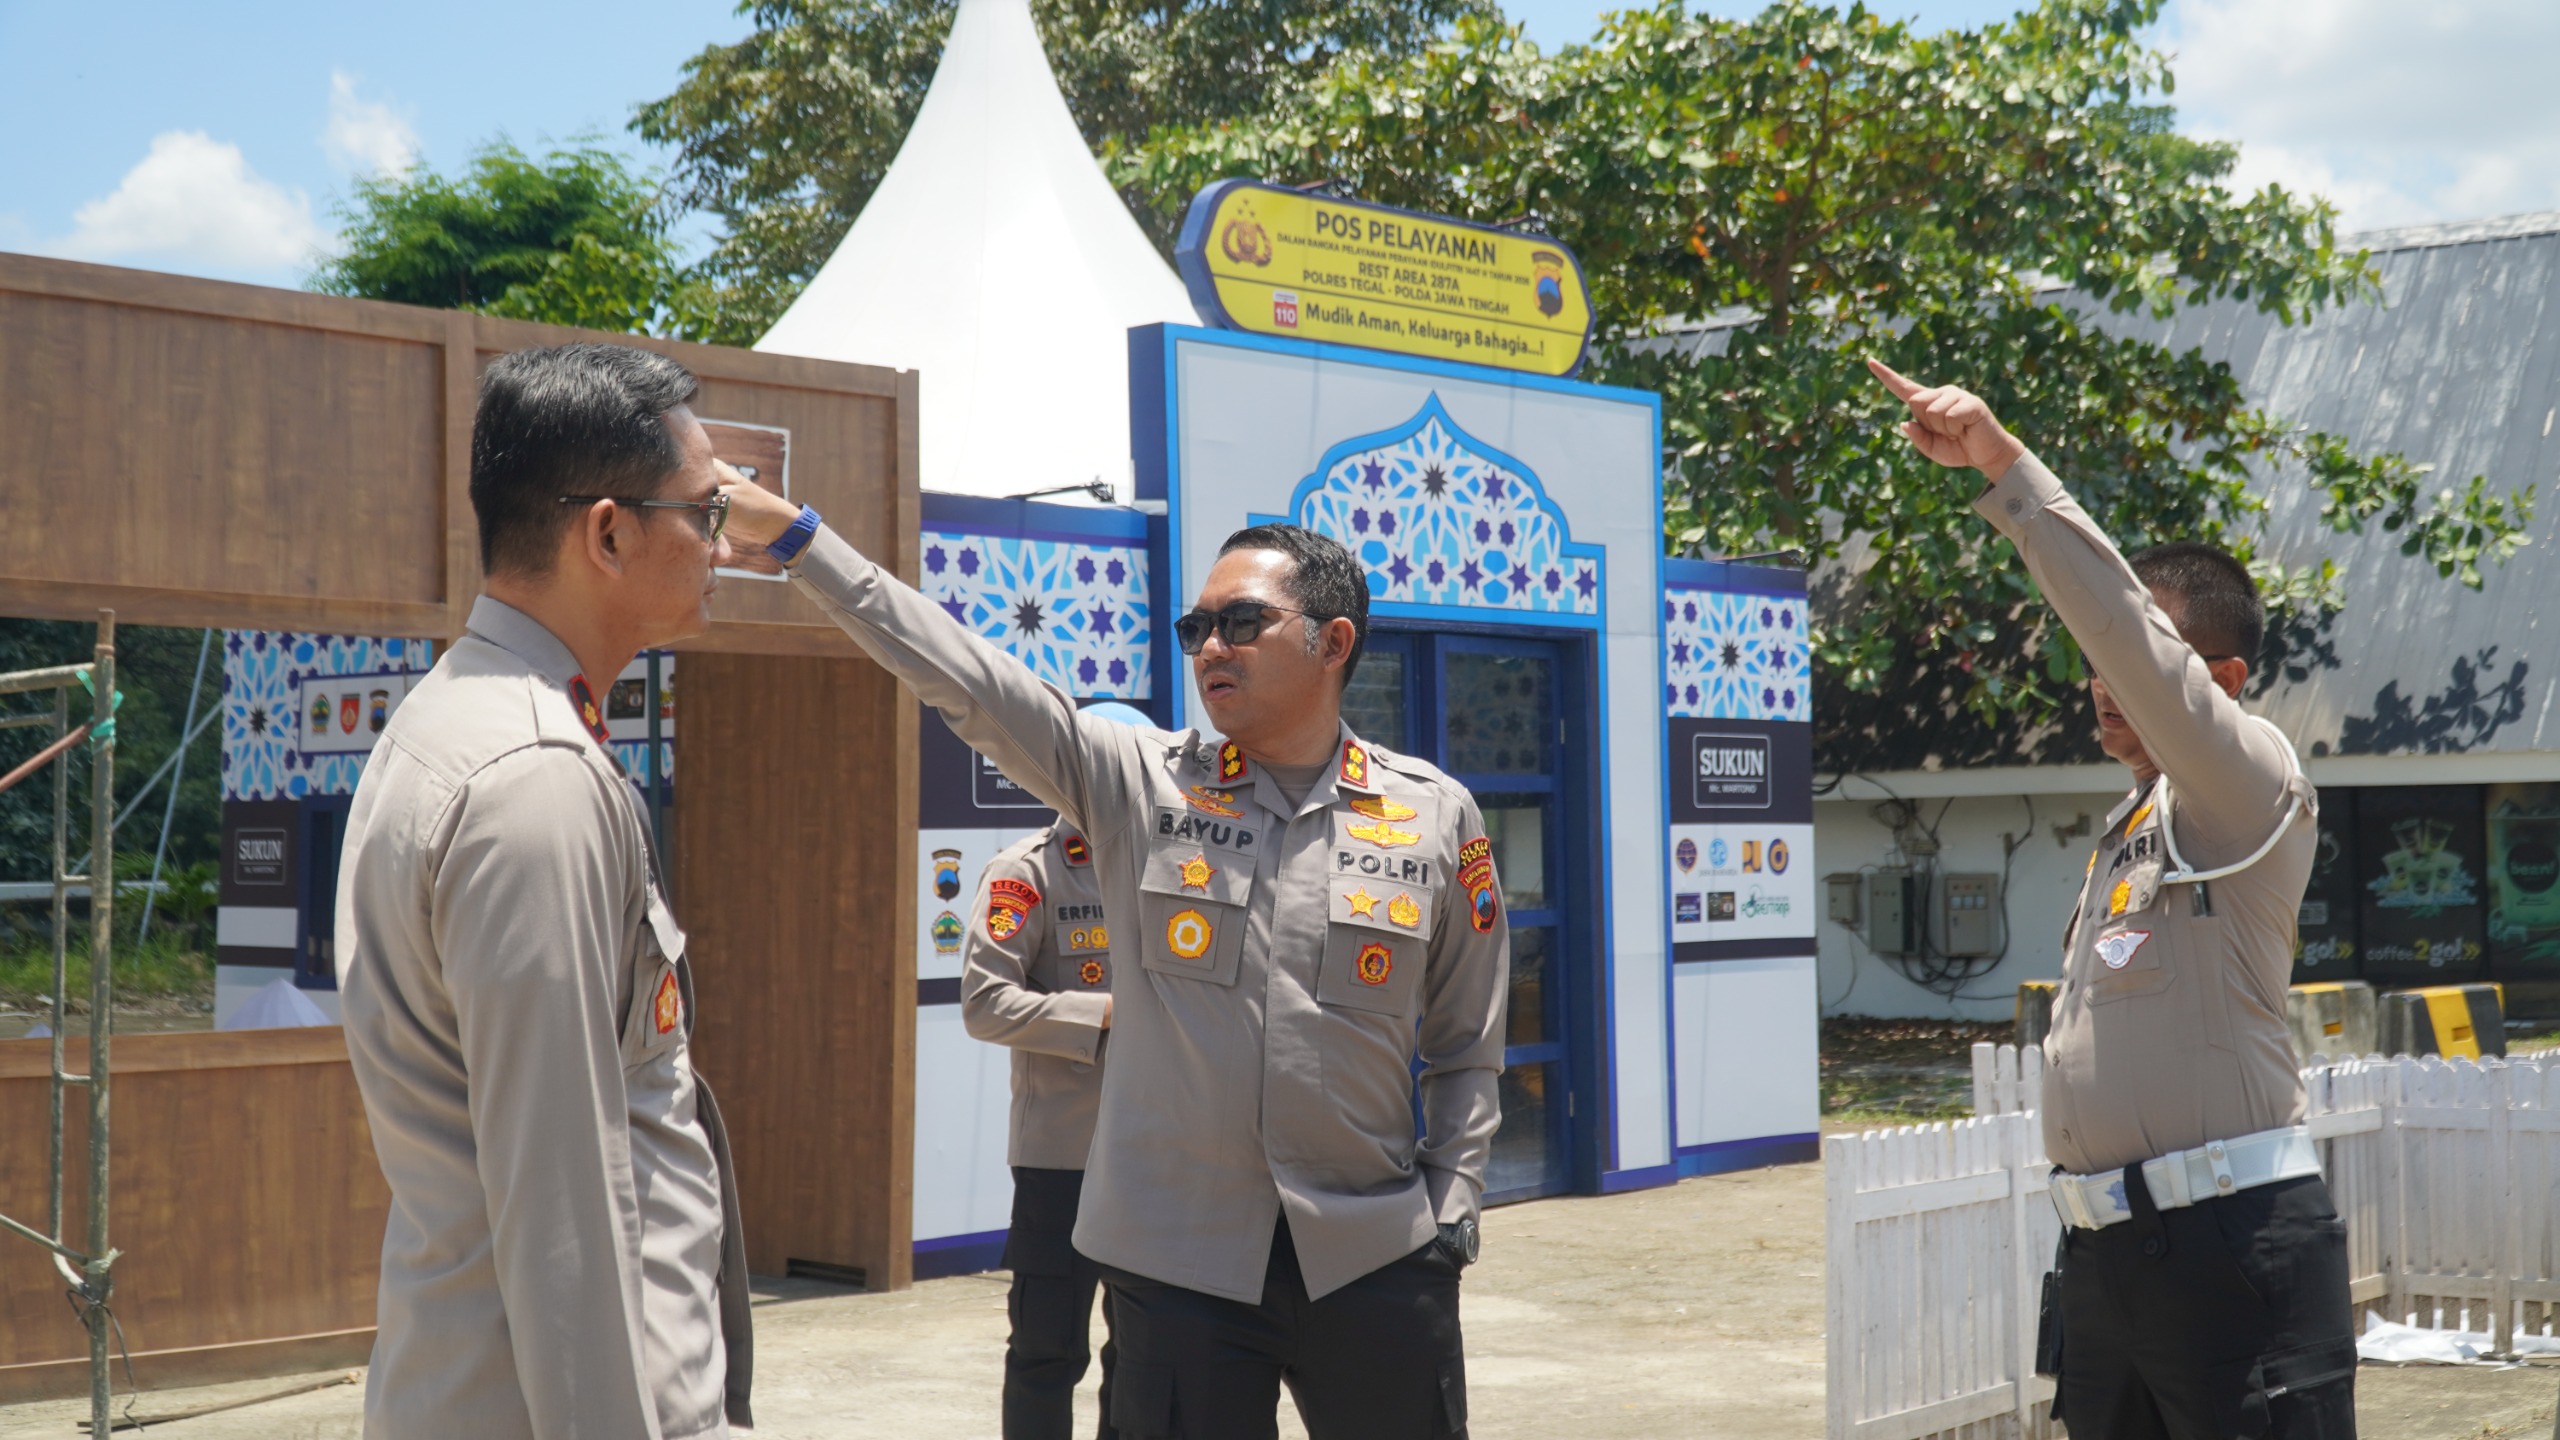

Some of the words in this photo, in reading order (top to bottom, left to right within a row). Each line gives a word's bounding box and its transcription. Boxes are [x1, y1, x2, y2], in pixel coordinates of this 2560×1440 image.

[1316, 210, 1361, 240] POS
[1369, 220, 1496, 265] PELAYANAN
[1303, 270, 1347, 288] POLRES
[1350, 277, 1385, 294] TEGAL
[1395, 285, 1431, 303] POLDA
[1434, 292, 1465, 308] JAWA
[1468, 297, 1509, 315] TENGAH
[1358, 262, 1389, 279] REST
[1393, 268, 1427, 286] AREA
[1430, 274, 1460, 292] 287A
[1275, 307, 1297, 325] 110
[1306, 302, 1354, 326] Mudik
[1358, 311, 1405, 336] Aman,
[1409, 318, 1471, 348] Keluarga
[1700, 748, 1765, 776] SUKUN
[239, 840, 282, 860] SUKUN
[1337, 851, 1428, 884] POLRI
